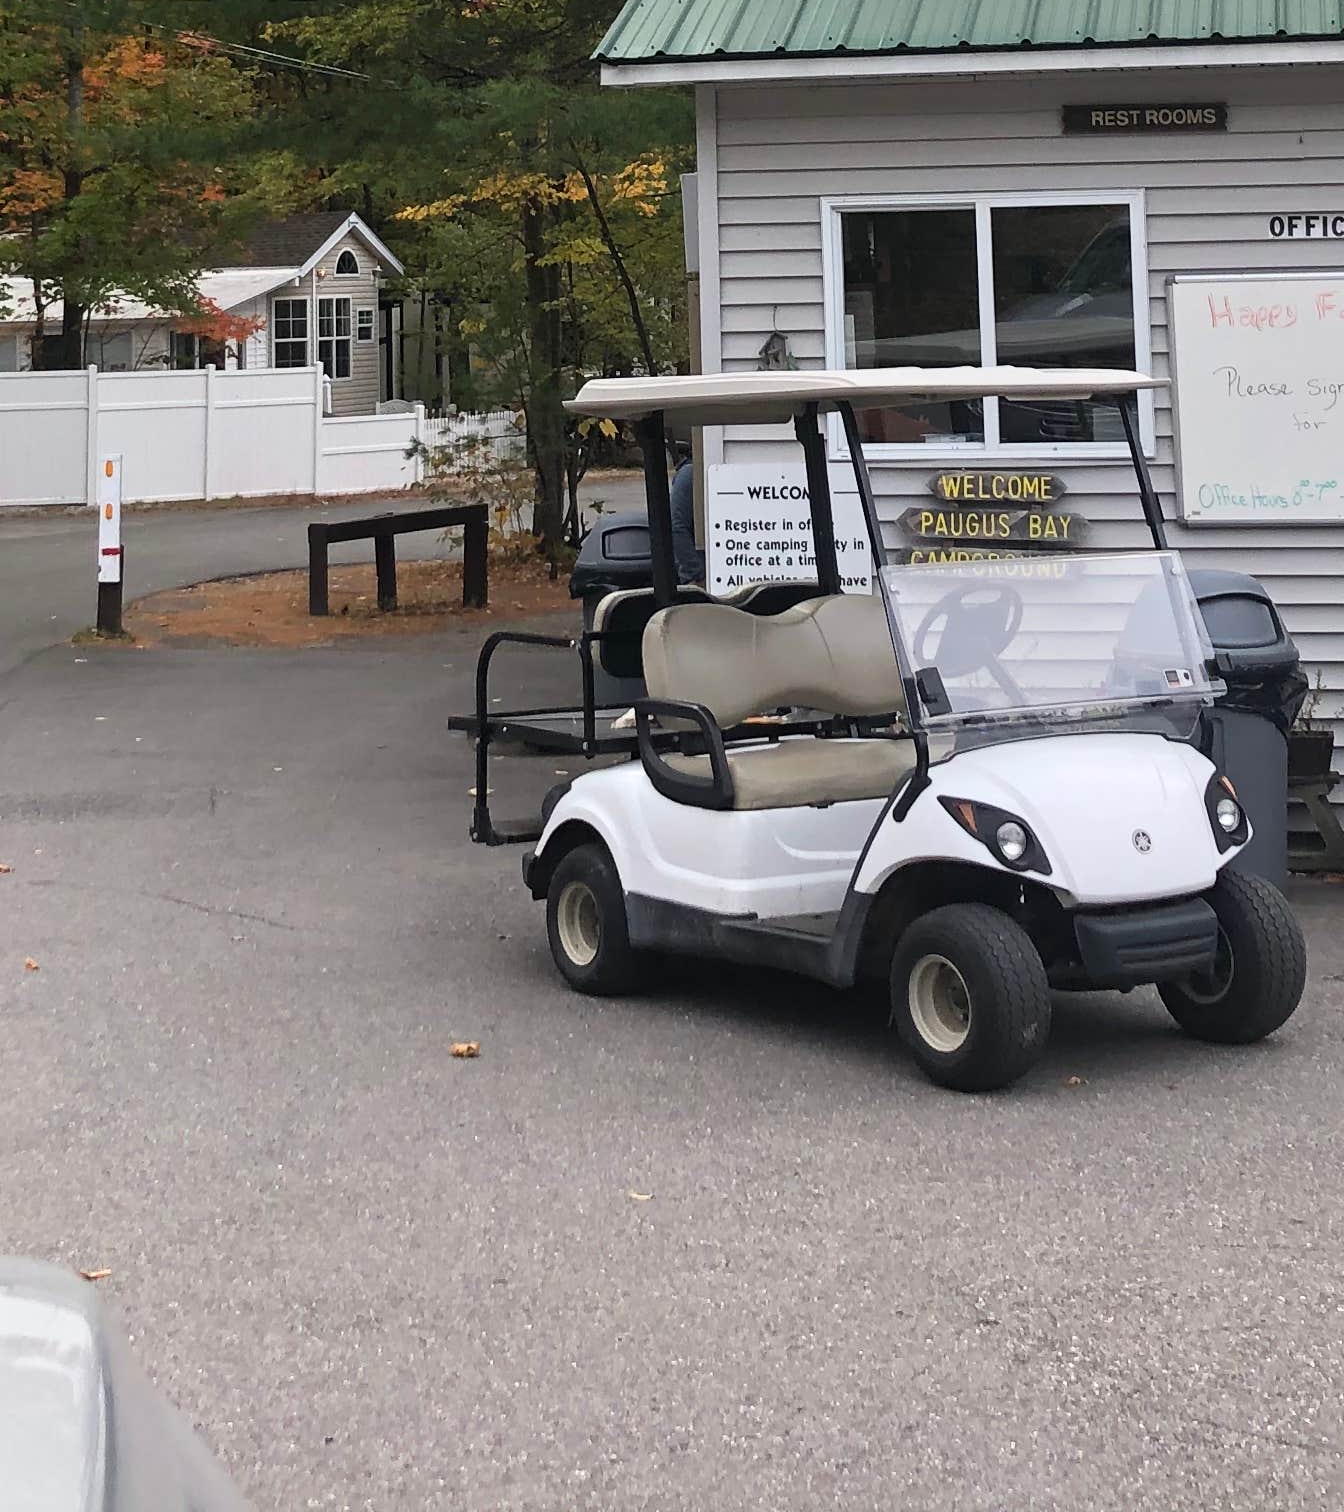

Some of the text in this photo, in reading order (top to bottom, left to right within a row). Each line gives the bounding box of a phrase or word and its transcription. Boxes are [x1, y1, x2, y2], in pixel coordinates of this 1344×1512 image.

[1091, 108, 1216, 127] REST ROOMS
[1207, 292, 1298, 331] Happy
[1212, 365, 1294, 398] Please
[1291, 410, 1328, 432] for
[941, 474, 1054, 500] WELCOME
[1198, 481, 1248, 509] Office
[1249, 480, 1289, 509] Hours
[725, 519, 777, 534] Register
[782, 519, 793, 530] in
[920, 511, 1072, 539] PAUGUS BAY
[725, 538, 808, 553] One camping
[853, 537, 865, 550] in
[725, 554, 762, 566] office
[768, 555, 781, 566] at
[786, 556, 793, 566] a
[910, 550, 1066, 579] CAMPGROUND
[727, 574, 744, 587] All
